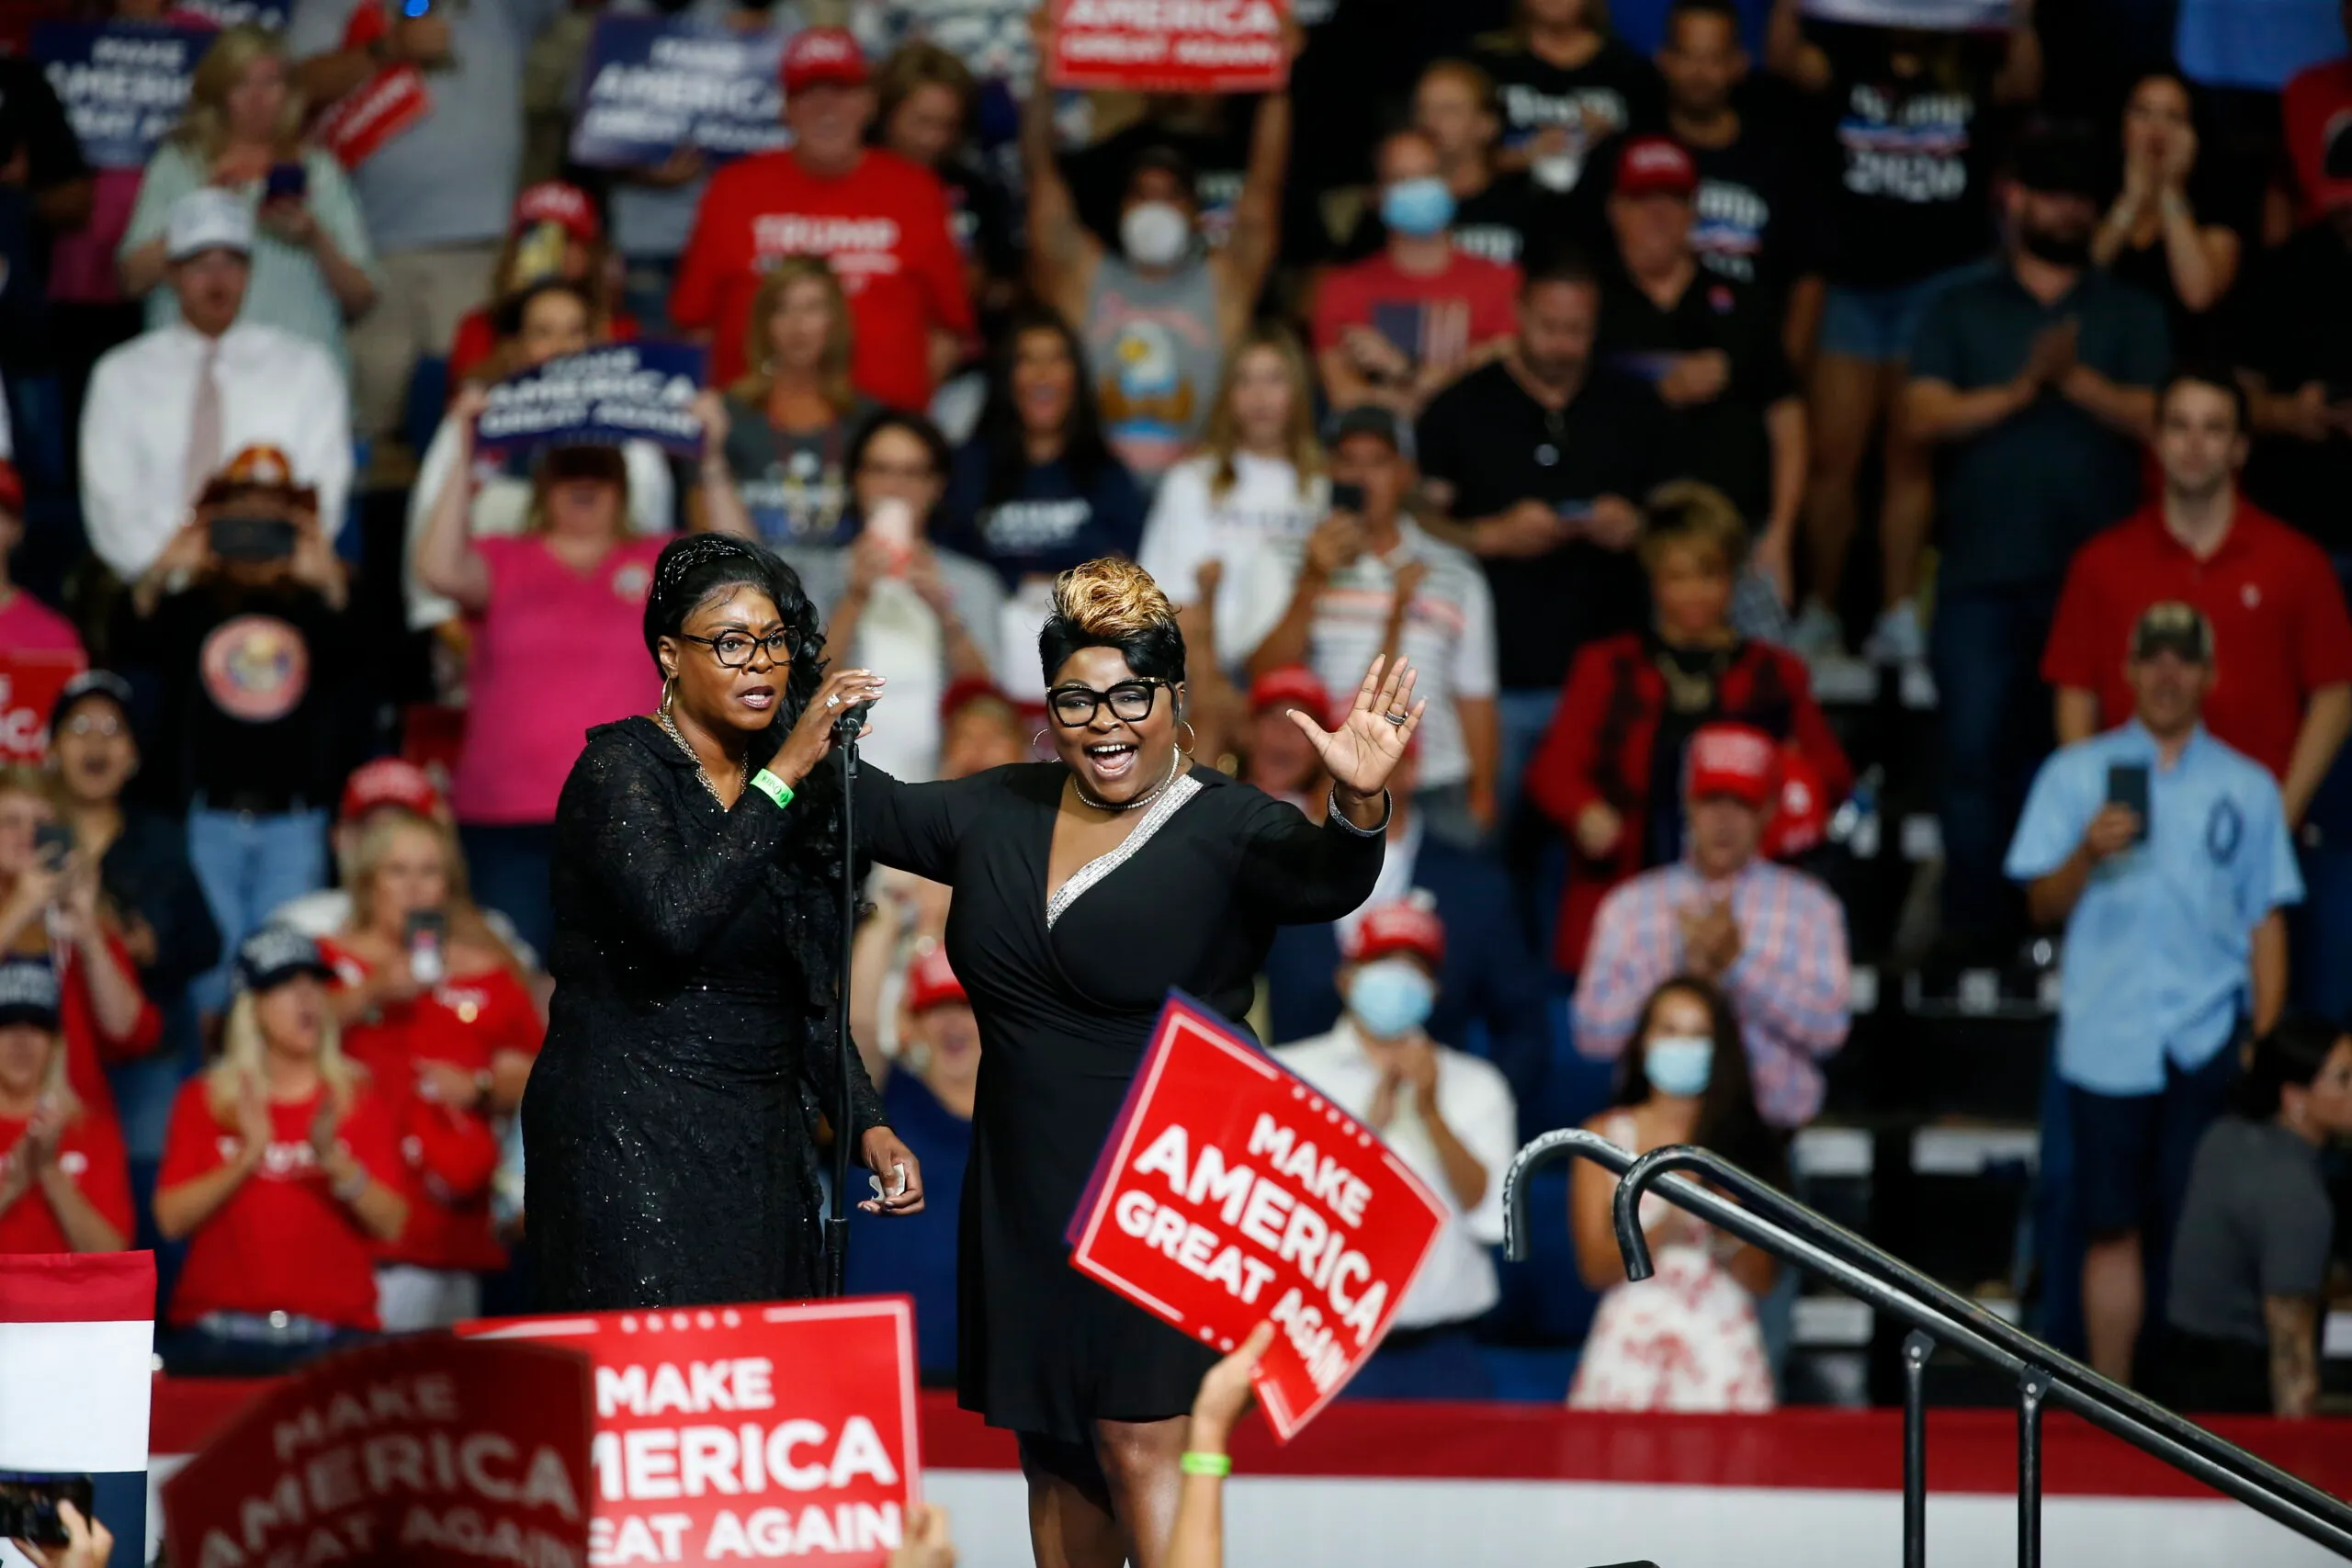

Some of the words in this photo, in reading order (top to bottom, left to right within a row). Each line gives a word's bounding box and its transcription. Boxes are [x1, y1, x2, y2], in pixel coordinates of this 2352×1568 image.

[1062, 0, 1279, 34] AMERICA
[751, 212, 901, 254] TRUMP
[1248, 1112, 1372, 1228] MAKE
[1114, 1190, 1276, 1304] GREAT
[1133, 1124, 1387, 1346] AMERICA
[594, 1357, 775, 1417] MAKE
[1270, 1288, 1351, 1394] AGAIN
[275, 1375, 455, 1461] MAKE
[200, 1429, 579, 1568] AMERICA
[588, 1512, 694, 1566] EAT
[704, 1501, 902, 1559] AGAIN
